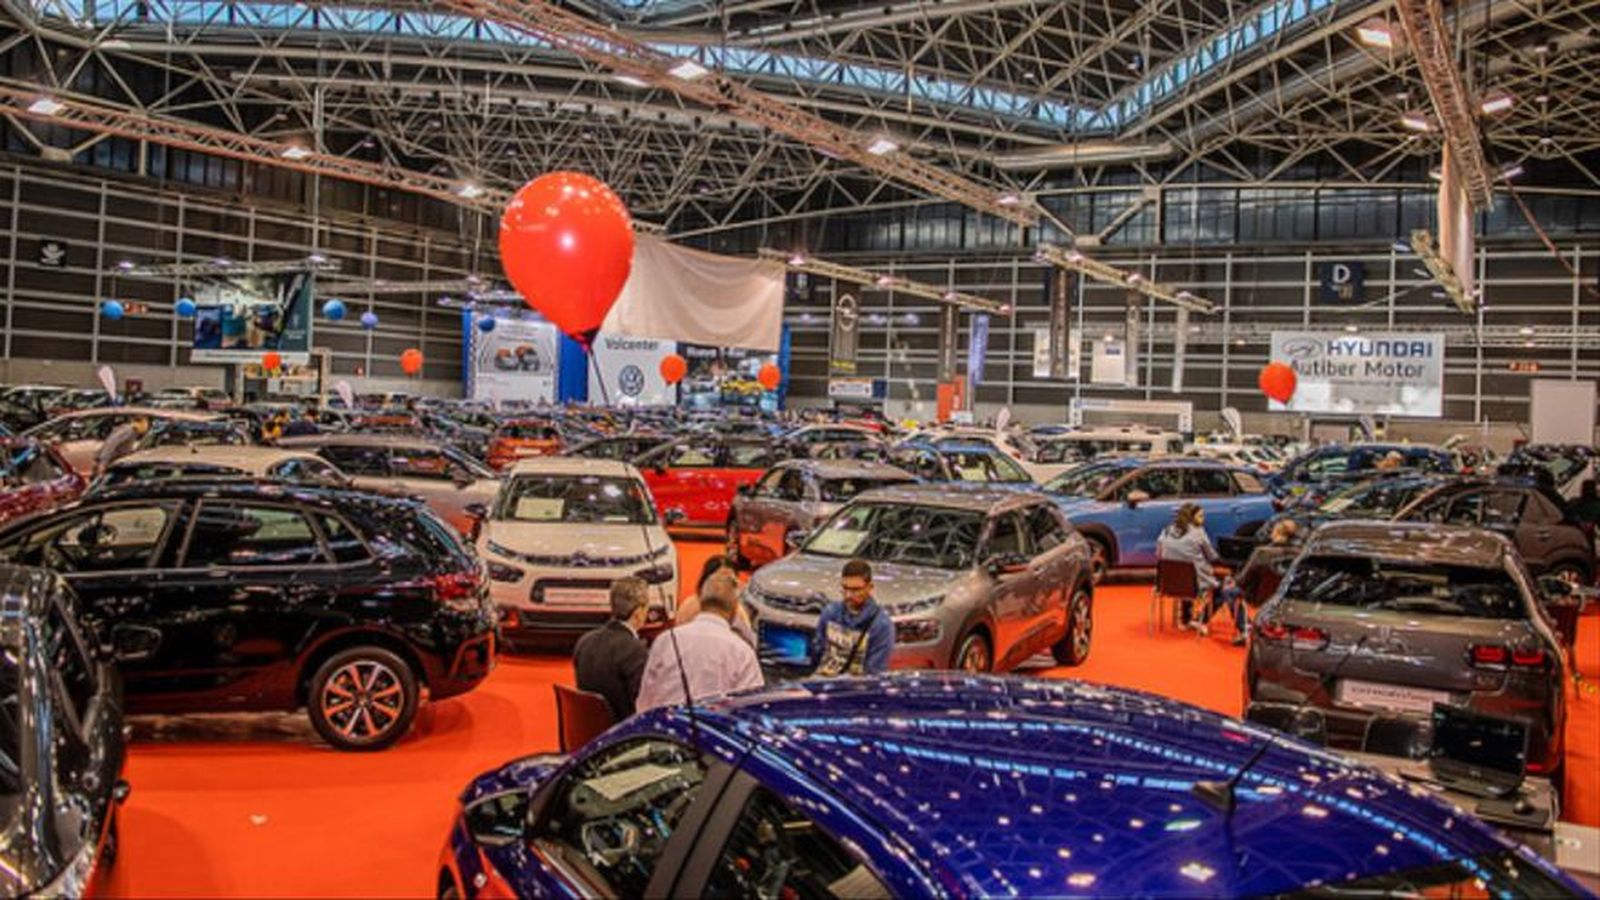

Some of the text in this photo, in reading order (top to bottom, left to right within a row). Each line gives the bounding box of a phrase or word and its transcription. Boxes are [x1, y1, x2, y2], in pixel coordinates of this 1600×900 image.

[1333, 264, 1351, 283] D
[1327, 340, 1433, 358] HYUNDAI
[1291, 359, 1426, 378] Autiber Motor
